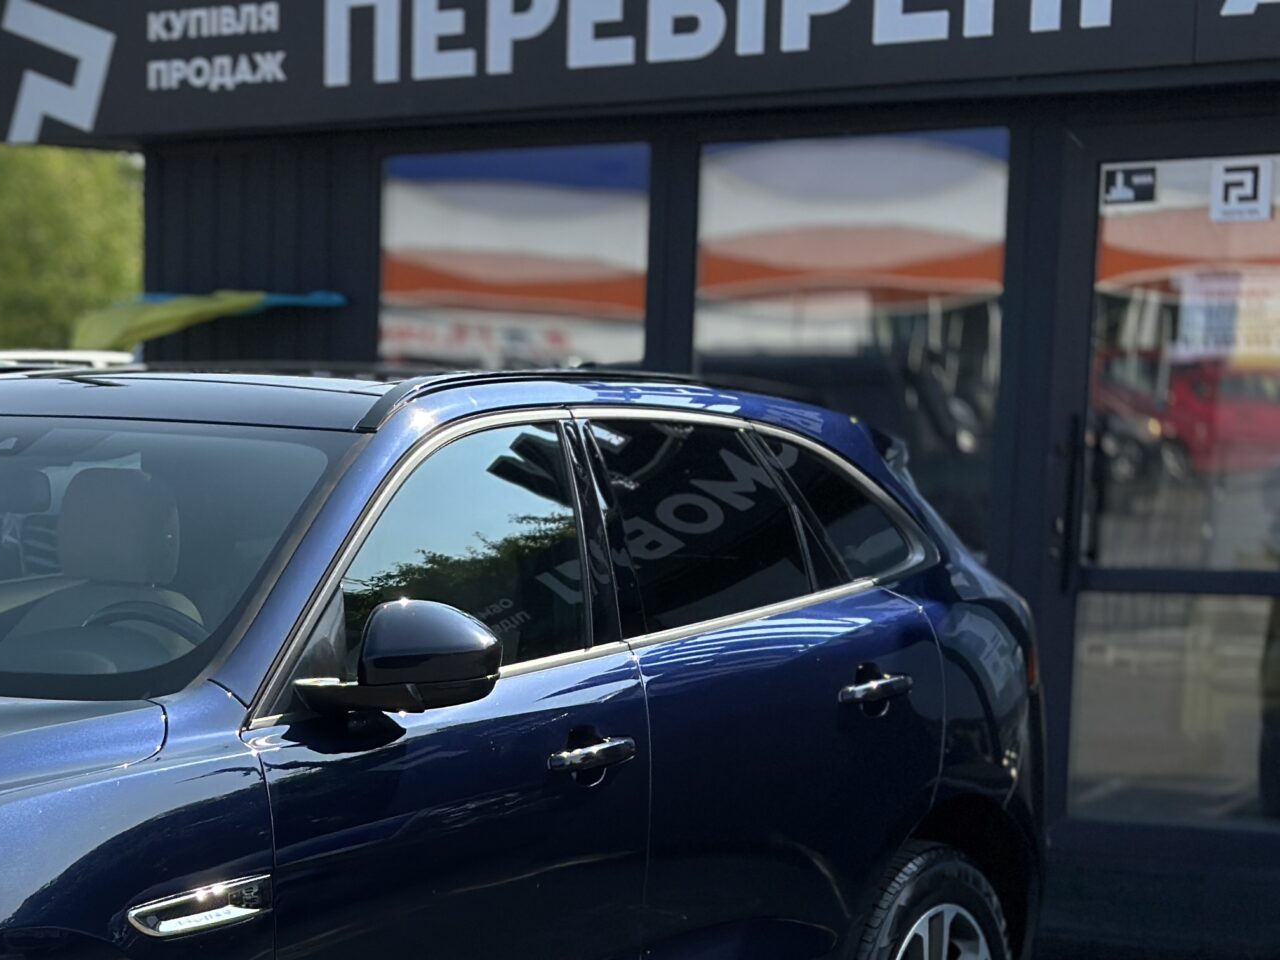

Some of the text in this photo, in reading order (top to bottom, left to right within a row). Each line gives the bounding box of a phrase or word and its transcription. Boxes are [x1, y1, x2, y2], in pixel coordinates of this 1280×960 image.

[146, 1, 280, 42] КУПІВЛЯ
[323, 0, 1114, 87] ПЕРЕВІ
[146, 50, 287, 92] ПРОДАЖ
